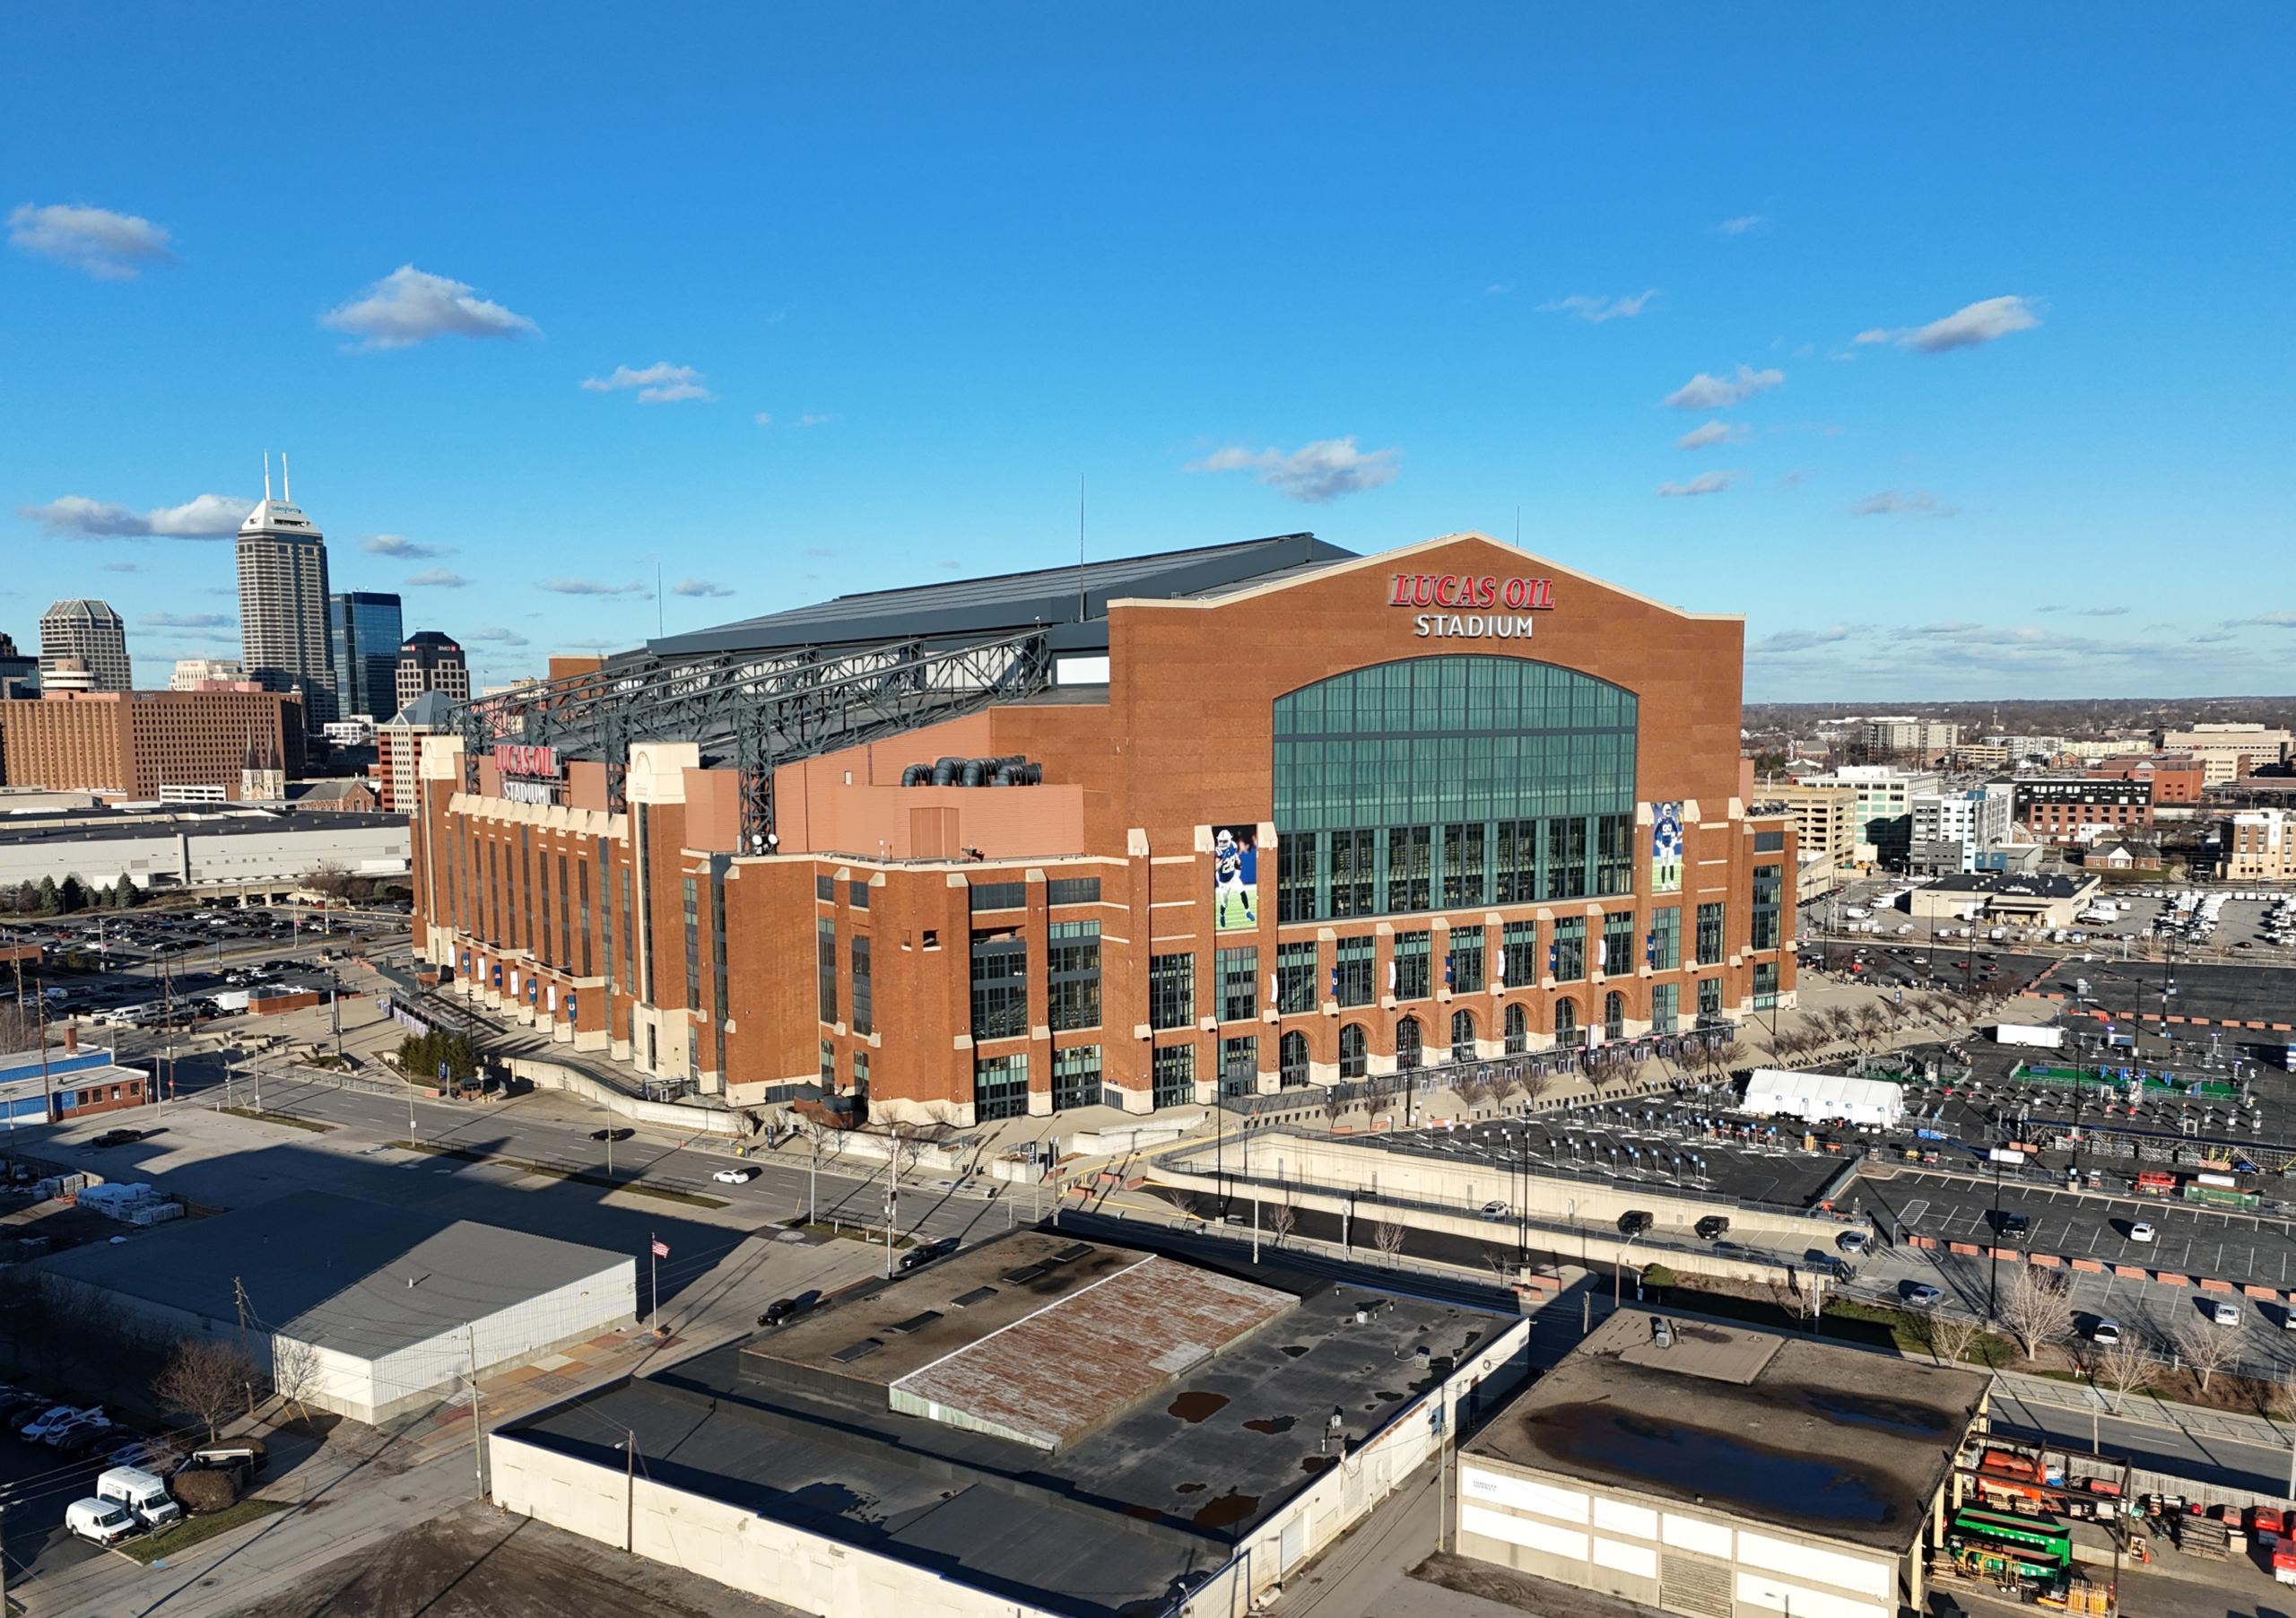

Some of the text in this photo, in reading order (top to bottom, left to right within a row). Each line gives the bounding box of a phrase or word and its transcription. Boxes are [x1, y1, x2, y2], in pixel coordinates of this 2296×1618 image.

[1391, 574, 1555, 609] LUCAS OIL
[1414, 614, 1533, 638] STADIUM
[494, 745, 553, 776] LUCAS OIL
[503, 781, 547, 804] STADIUM
